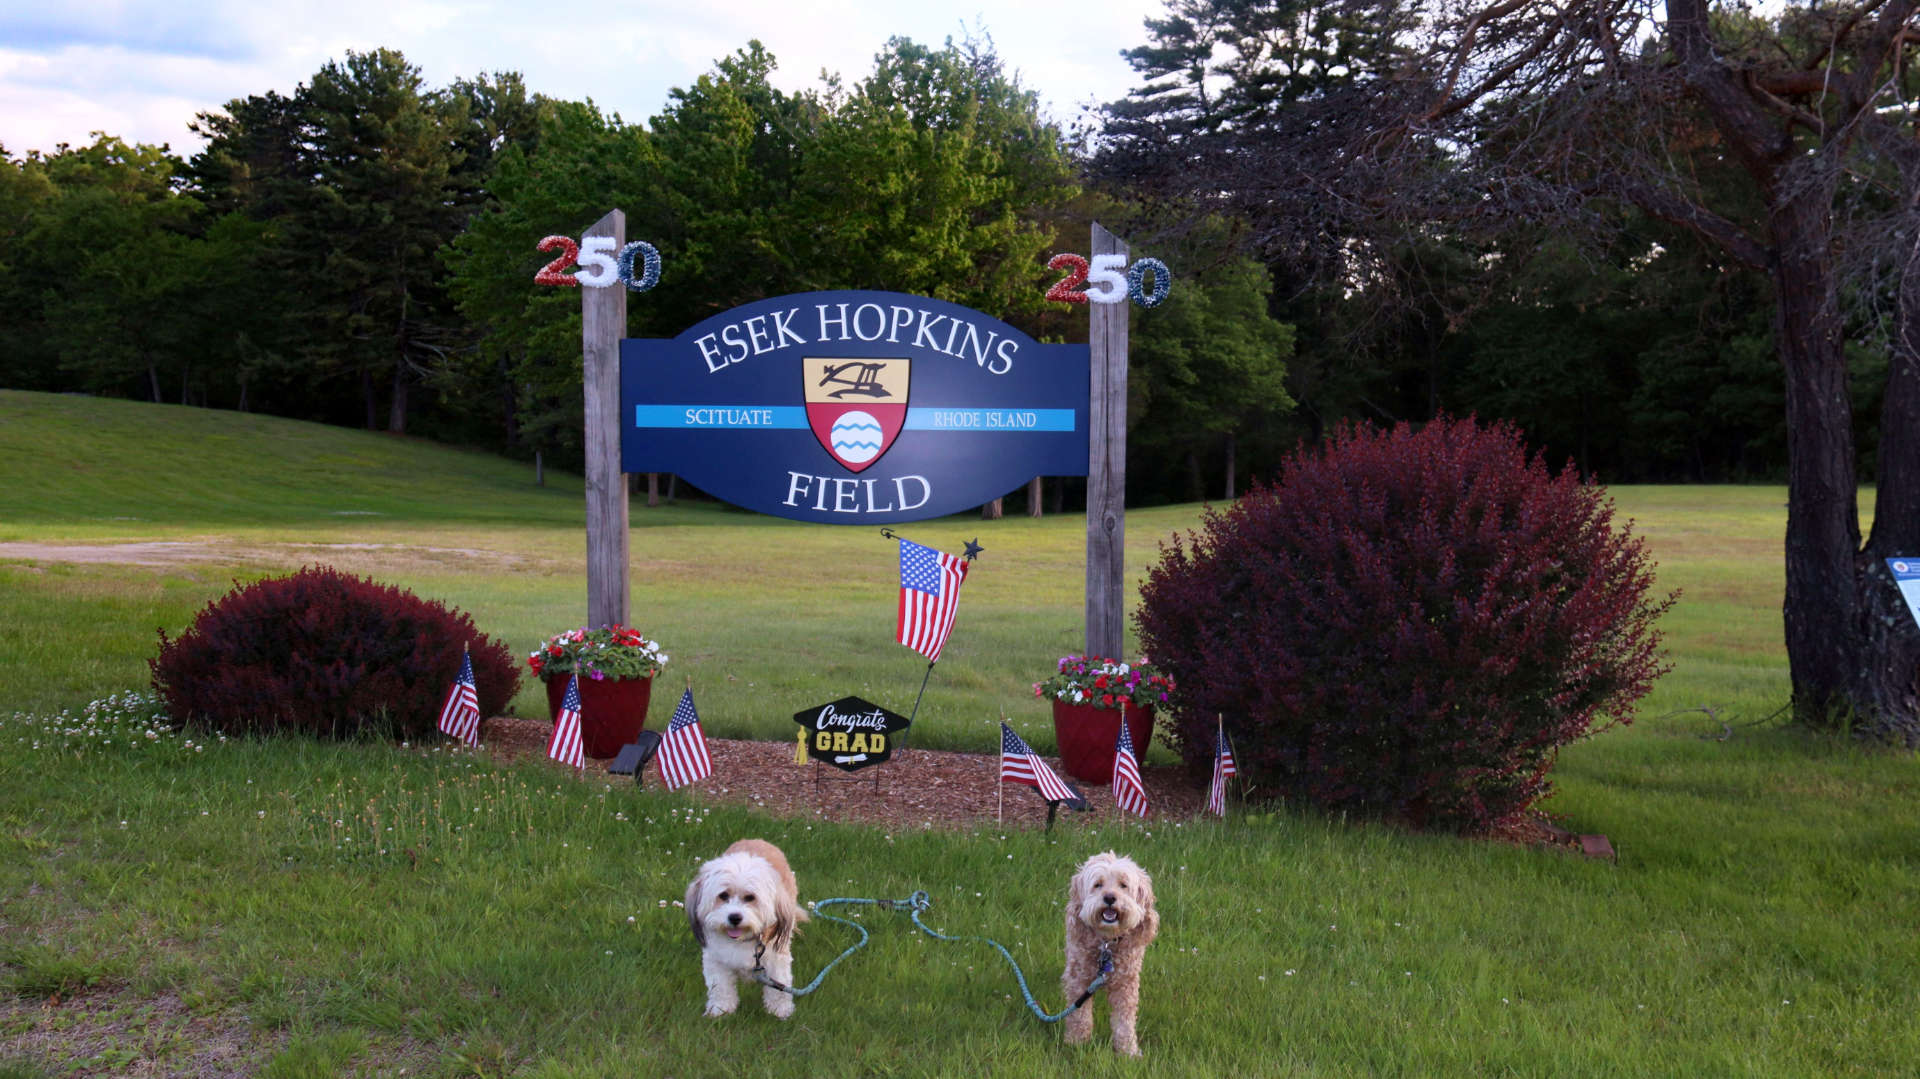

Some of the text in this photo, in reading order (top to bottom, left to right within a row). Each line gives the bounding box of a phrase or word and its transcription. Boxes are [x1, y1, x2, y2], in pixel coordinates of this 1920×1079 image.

[534, 235, 661, 292] 250
[1045, 253, 1170, 308] 250
[694, 303, 1019, 375] ESEK HOPKINS
[685, 409, 773, 426] SCITUATE
[934, 411, 1037, 428] RHODE ISLAND
[782, 471, 932, 513] FIELD
[816, 704, 887, 734] Congrats
[816, 731, 886, 753] GRAD
